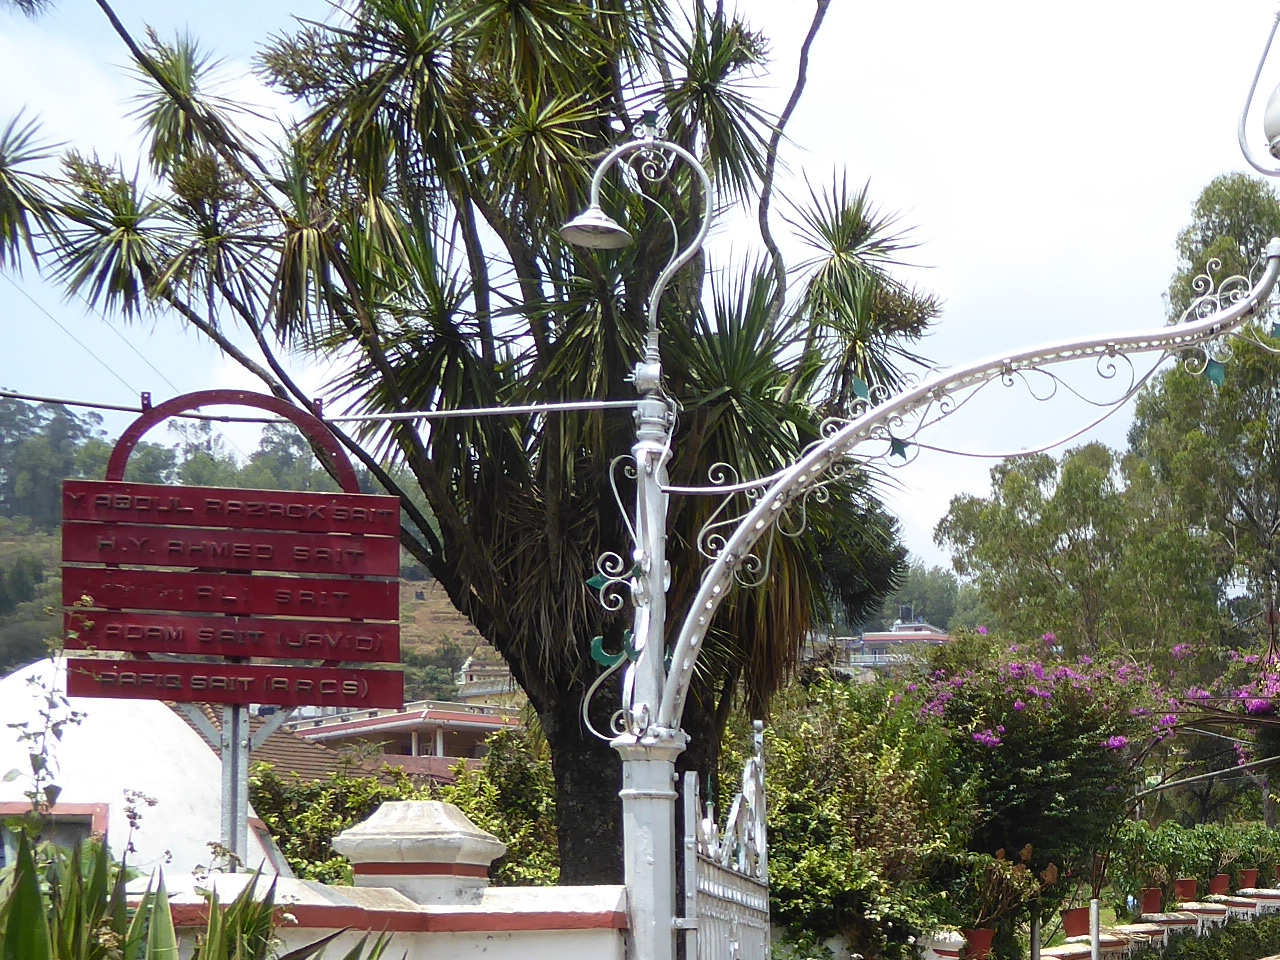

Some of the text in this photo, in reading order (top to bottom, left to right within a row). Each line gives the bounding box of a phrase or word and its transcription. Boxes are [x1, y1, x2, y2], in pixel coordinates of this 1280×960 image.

[95, 493, 195, 512] ABDUL
[204, 498, 327, 521] RAZACK
[332, 506, 395, 523] SAIT
[168, 540, 273, 560] AHMED
[293, 546, 366, 565] SAIT
[275, 588, 349, 605] SAIT
[106, 623, 185, 642] ADAM
[198, 627, 266, 645] SAIT
[98, 671, 369, 699] RAFIQ SAIT (ARCS)
